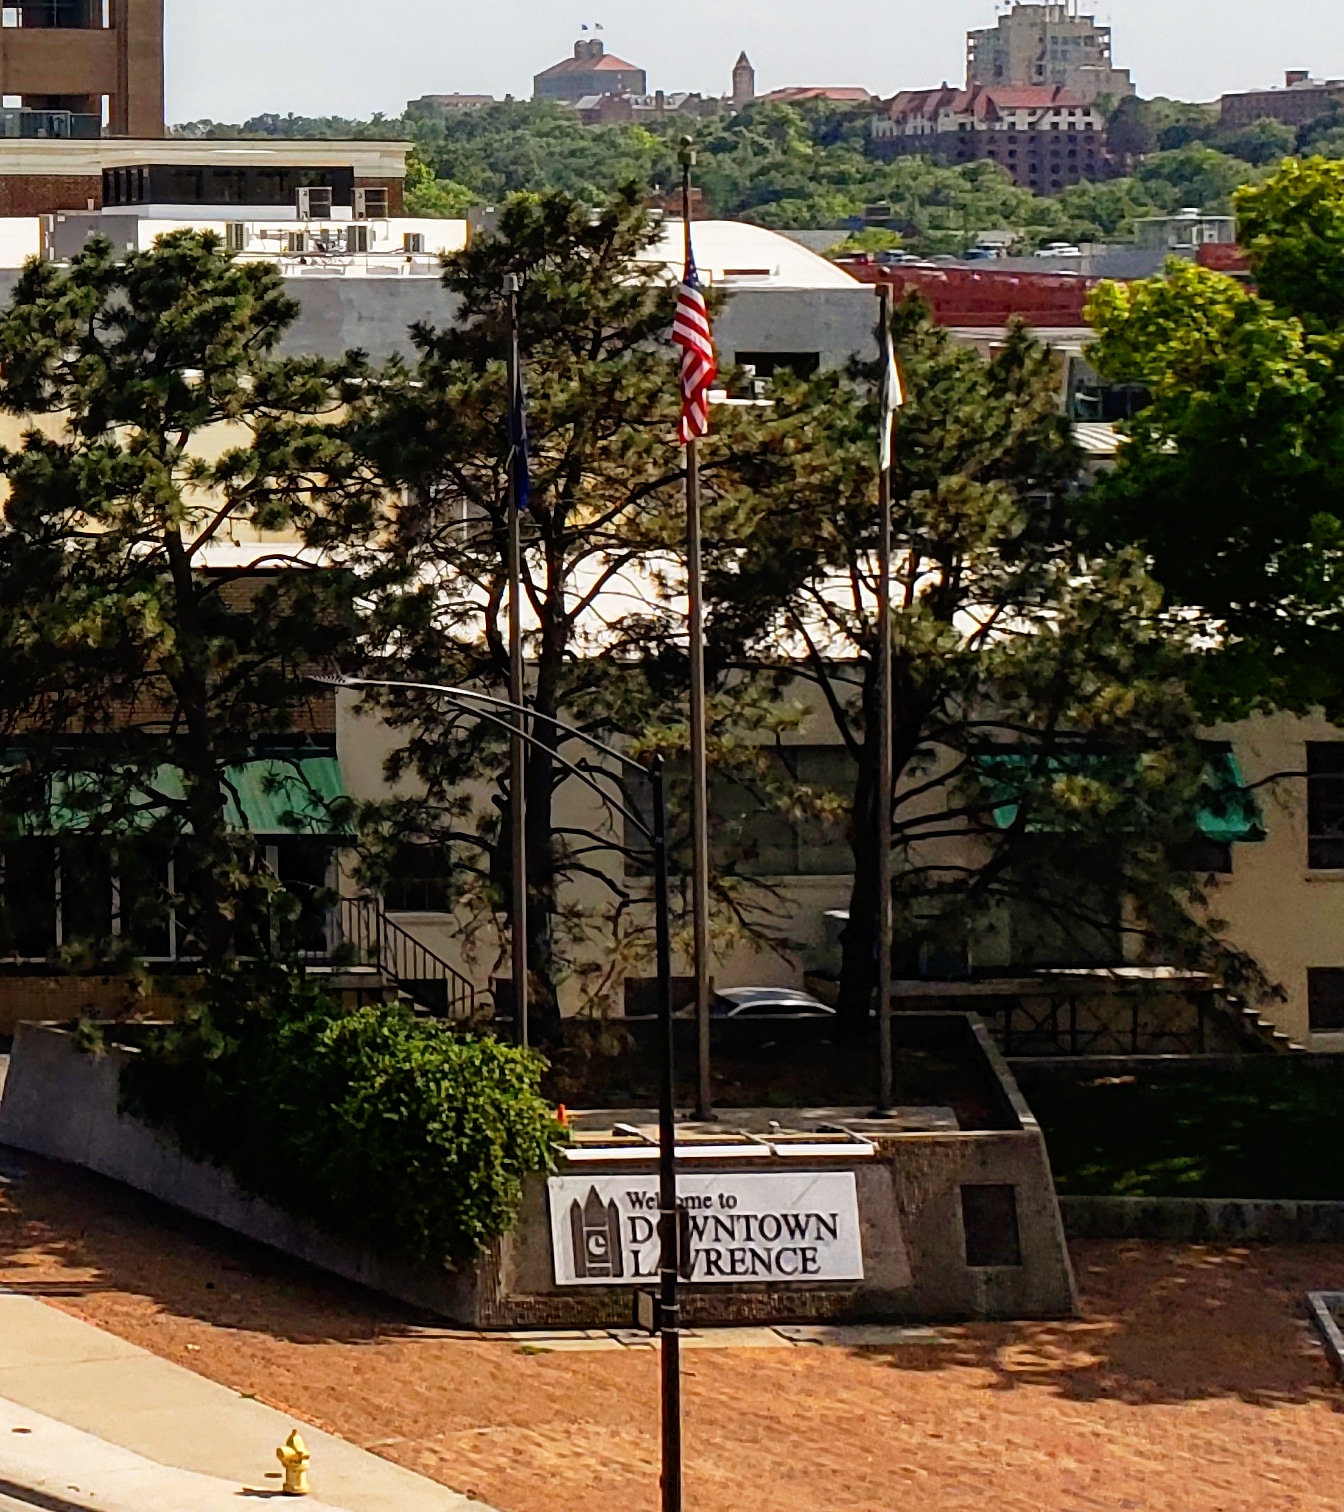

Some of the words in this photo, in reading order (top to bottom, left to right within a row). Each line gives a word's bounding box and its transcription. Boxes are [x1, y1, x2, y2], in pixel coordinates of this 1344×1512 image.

[626, 1191, 712, 1210] Welome
[717, 1193, 738, 1210] to
[627, 1212, 838, 1244] DWNTOWN
[631, 1247, 822, 1278] LRENCE
